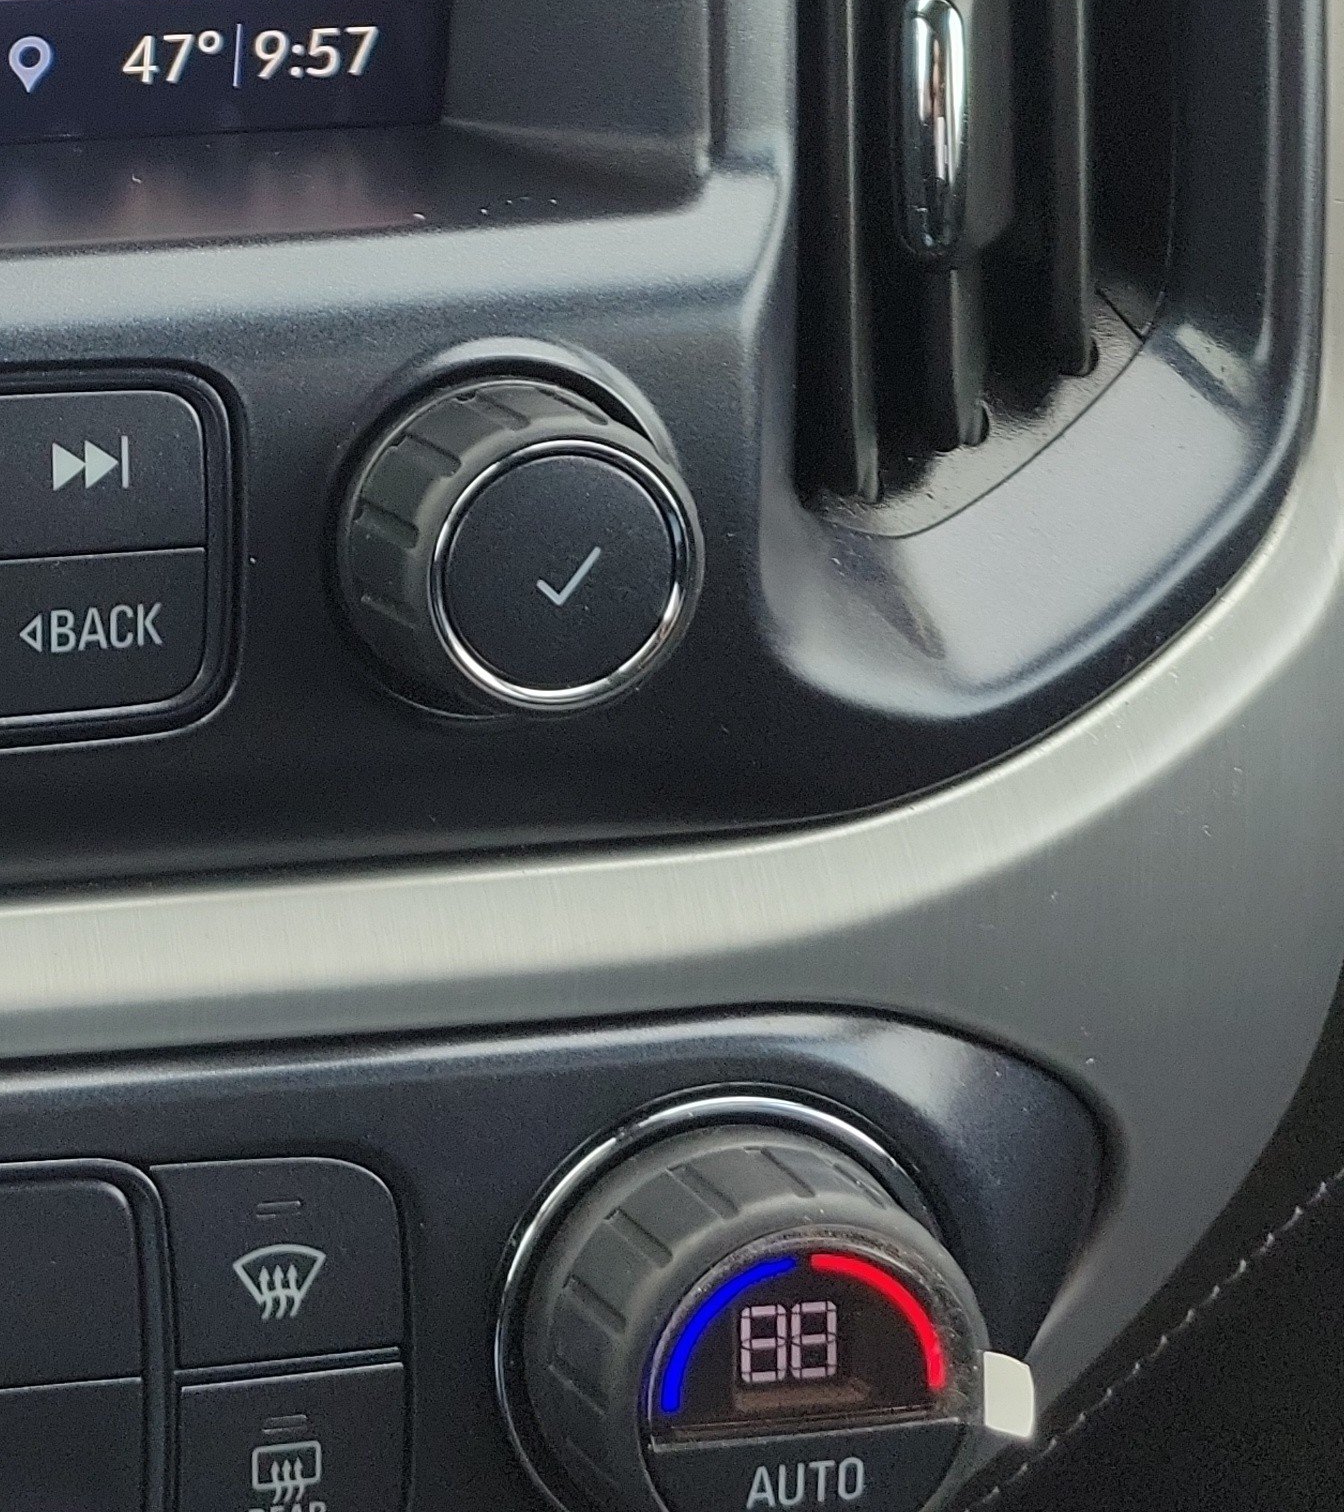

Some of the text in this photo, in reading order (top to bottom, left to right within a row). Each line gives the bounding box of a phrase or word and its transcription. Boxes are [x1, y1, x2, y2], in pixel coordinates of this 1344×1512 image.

[122, 30, 224, 84] 47°
[254, 26, 380, 79] 9:57
[50, 602, 163, 653] BACK
[740, 1300, 838, 1383] 88
[746, 1456, 865, 1509] AUTO
